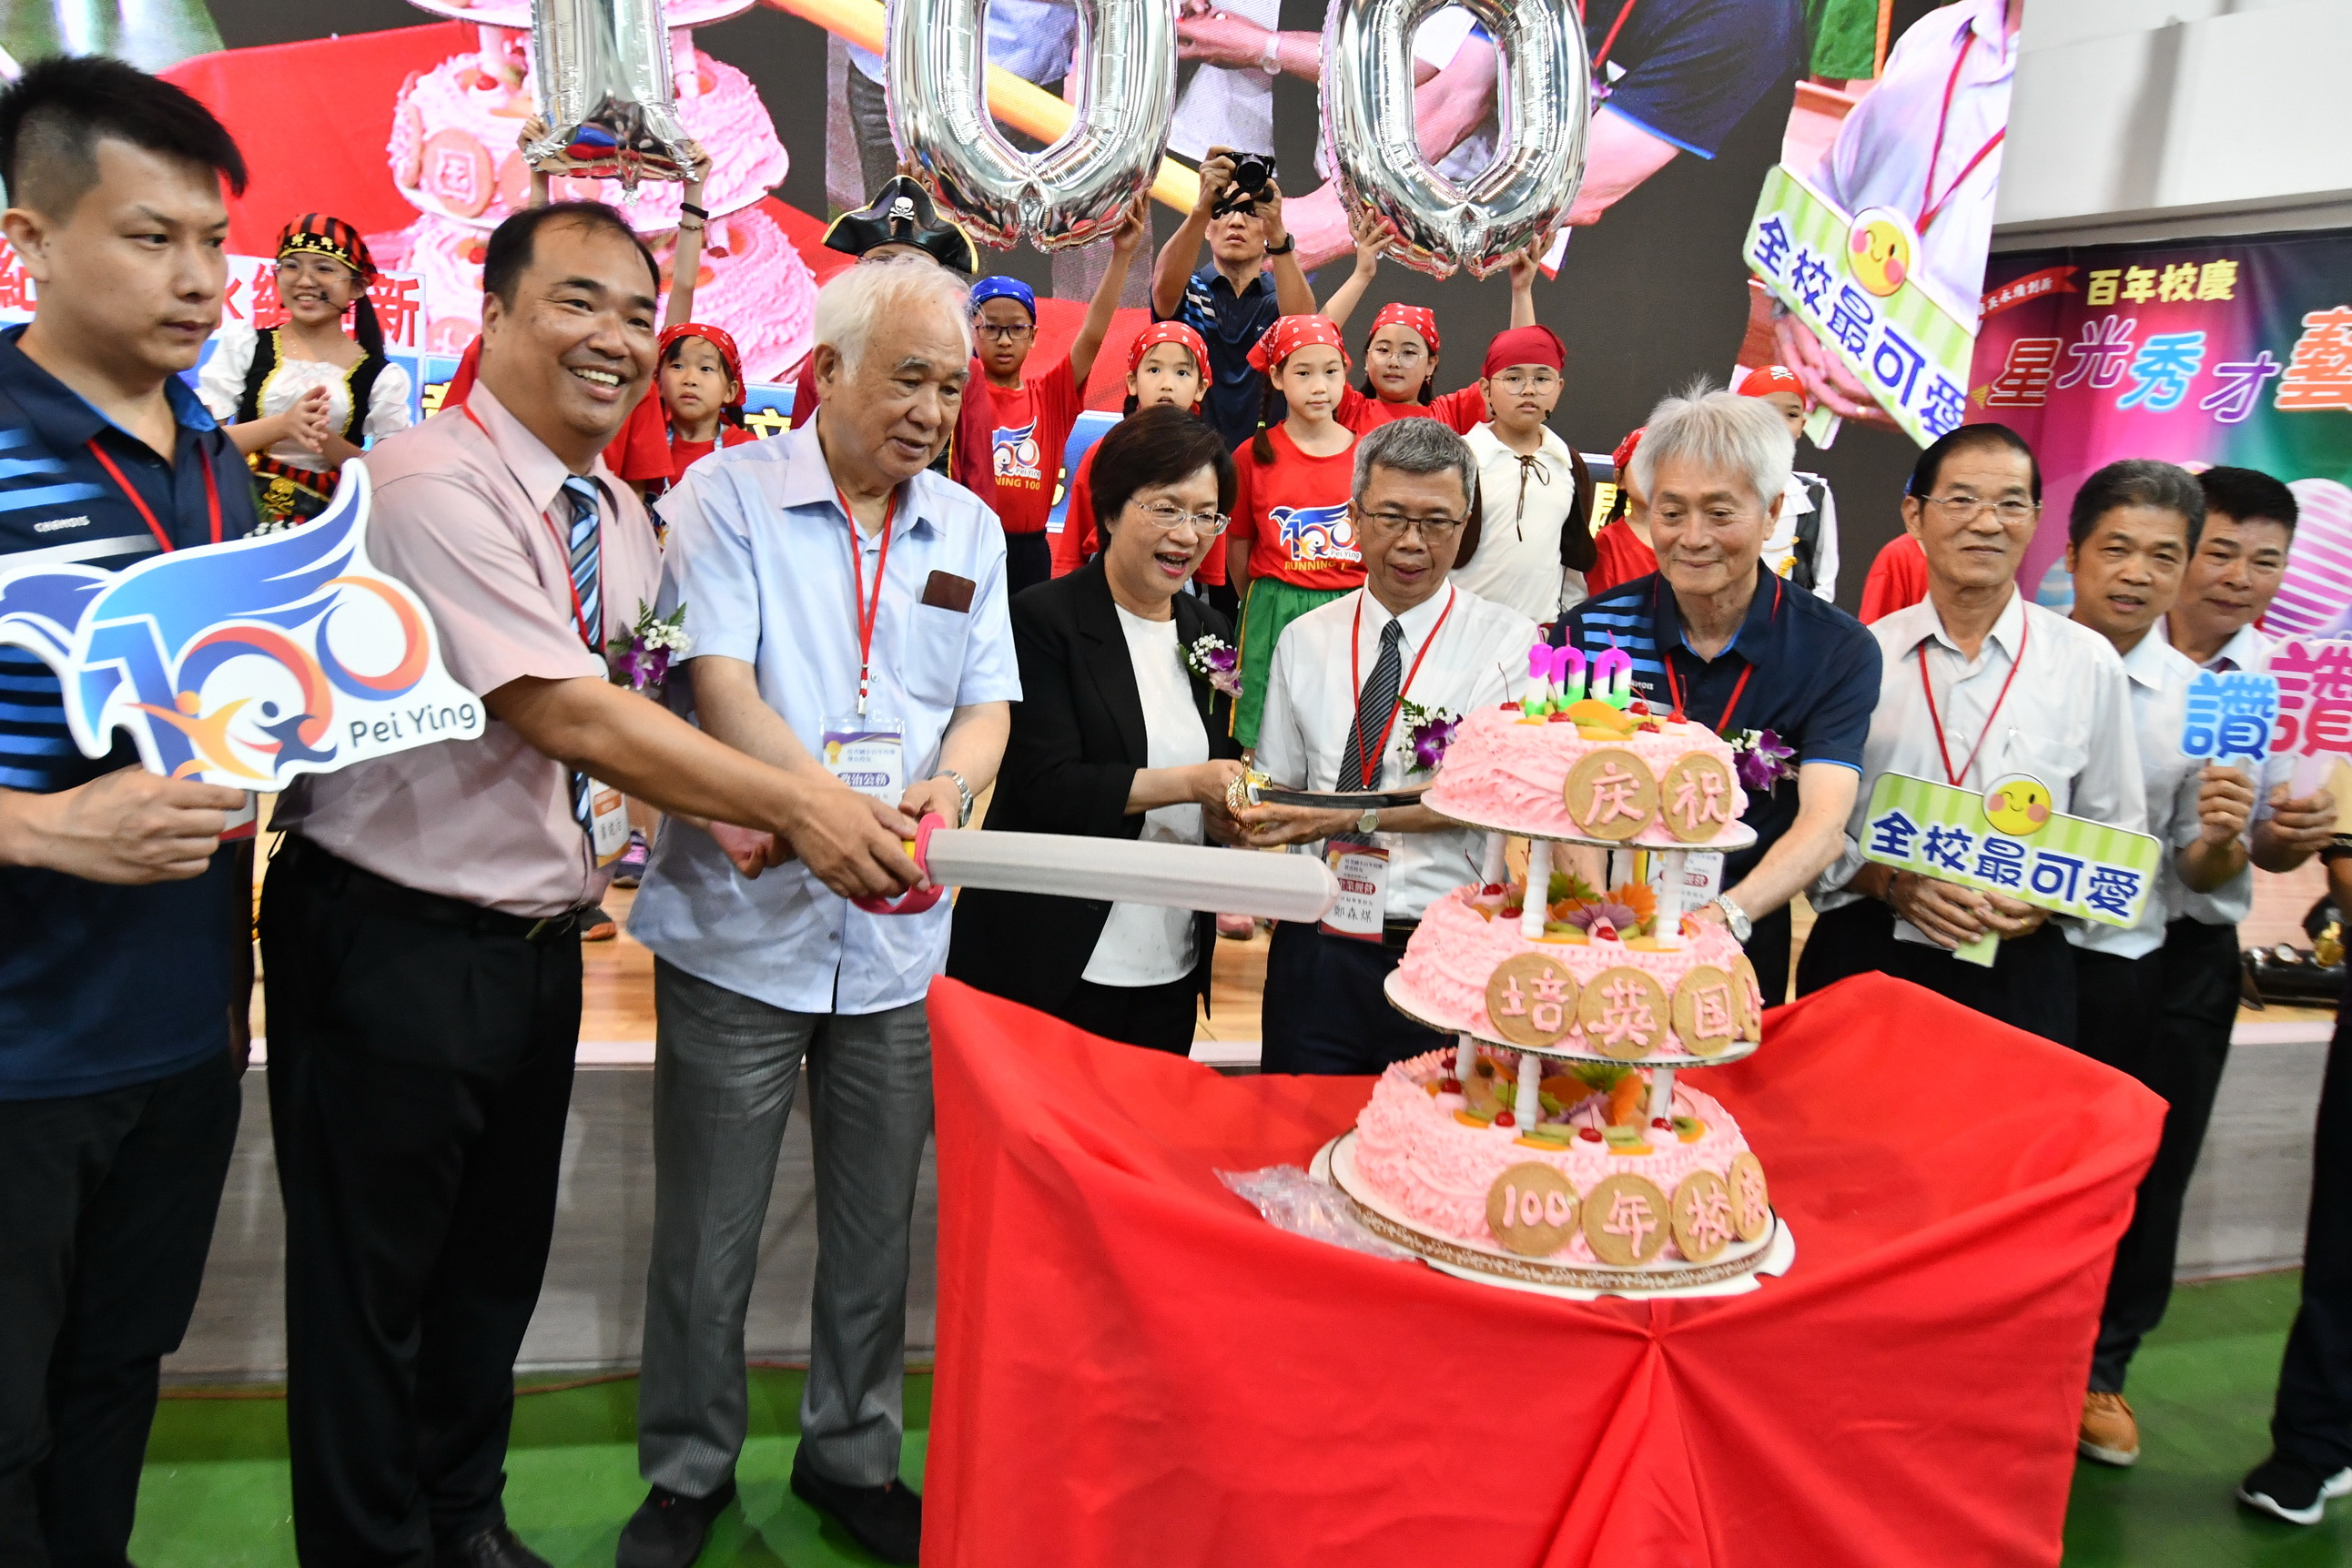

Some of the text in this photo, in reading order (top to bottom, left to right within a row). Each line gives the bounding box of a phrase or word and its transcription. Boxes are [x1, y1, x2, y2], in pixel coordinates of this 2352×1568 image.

[2087, 259, 2239, 306] 百年校慶
[1753, 217, 1966, 439] 全校最可愛
[1025, 480, 1040, 490] 100
[1525, 642, 1632, 717] 100
[350, 703, 476, 748] Pei Ying
[2184, 673, 2276, 760] 讚
[1583, 761, 1729, 830] 庆祝
[1870, 811, 2141, 918] 全校最可愛
